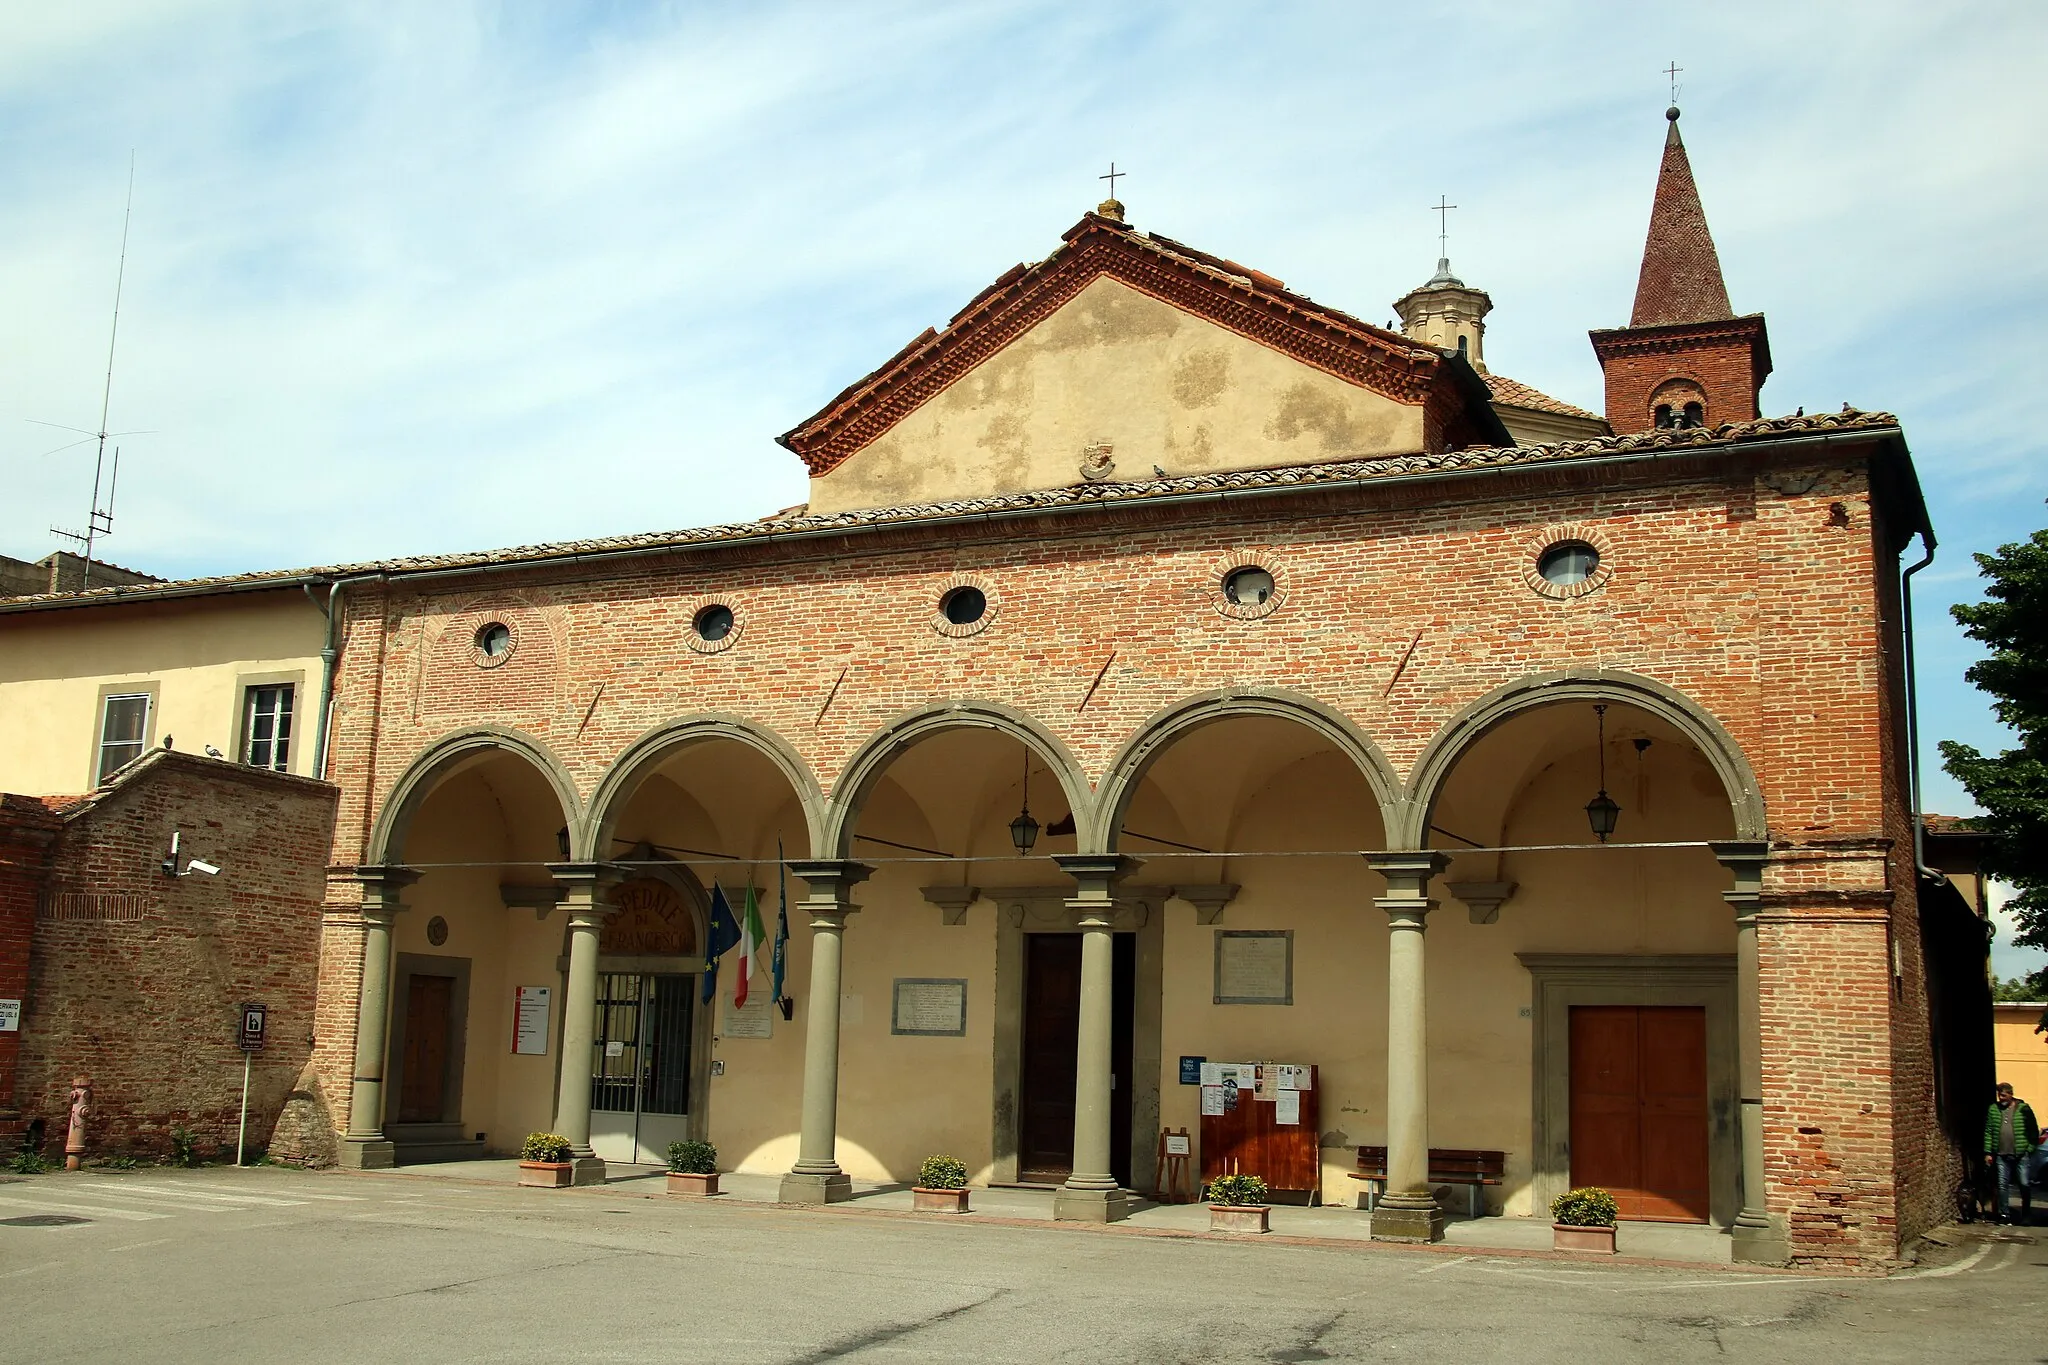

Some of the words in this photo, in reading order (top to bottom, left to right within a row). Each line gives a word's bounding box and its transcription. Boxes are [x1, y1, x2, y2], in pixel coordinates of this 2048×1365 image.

[603, 887, 684, 926] OSPEDALE
[635, 914, 648, 926] DI
[608, 930, 688, 951] FRANCESCO
